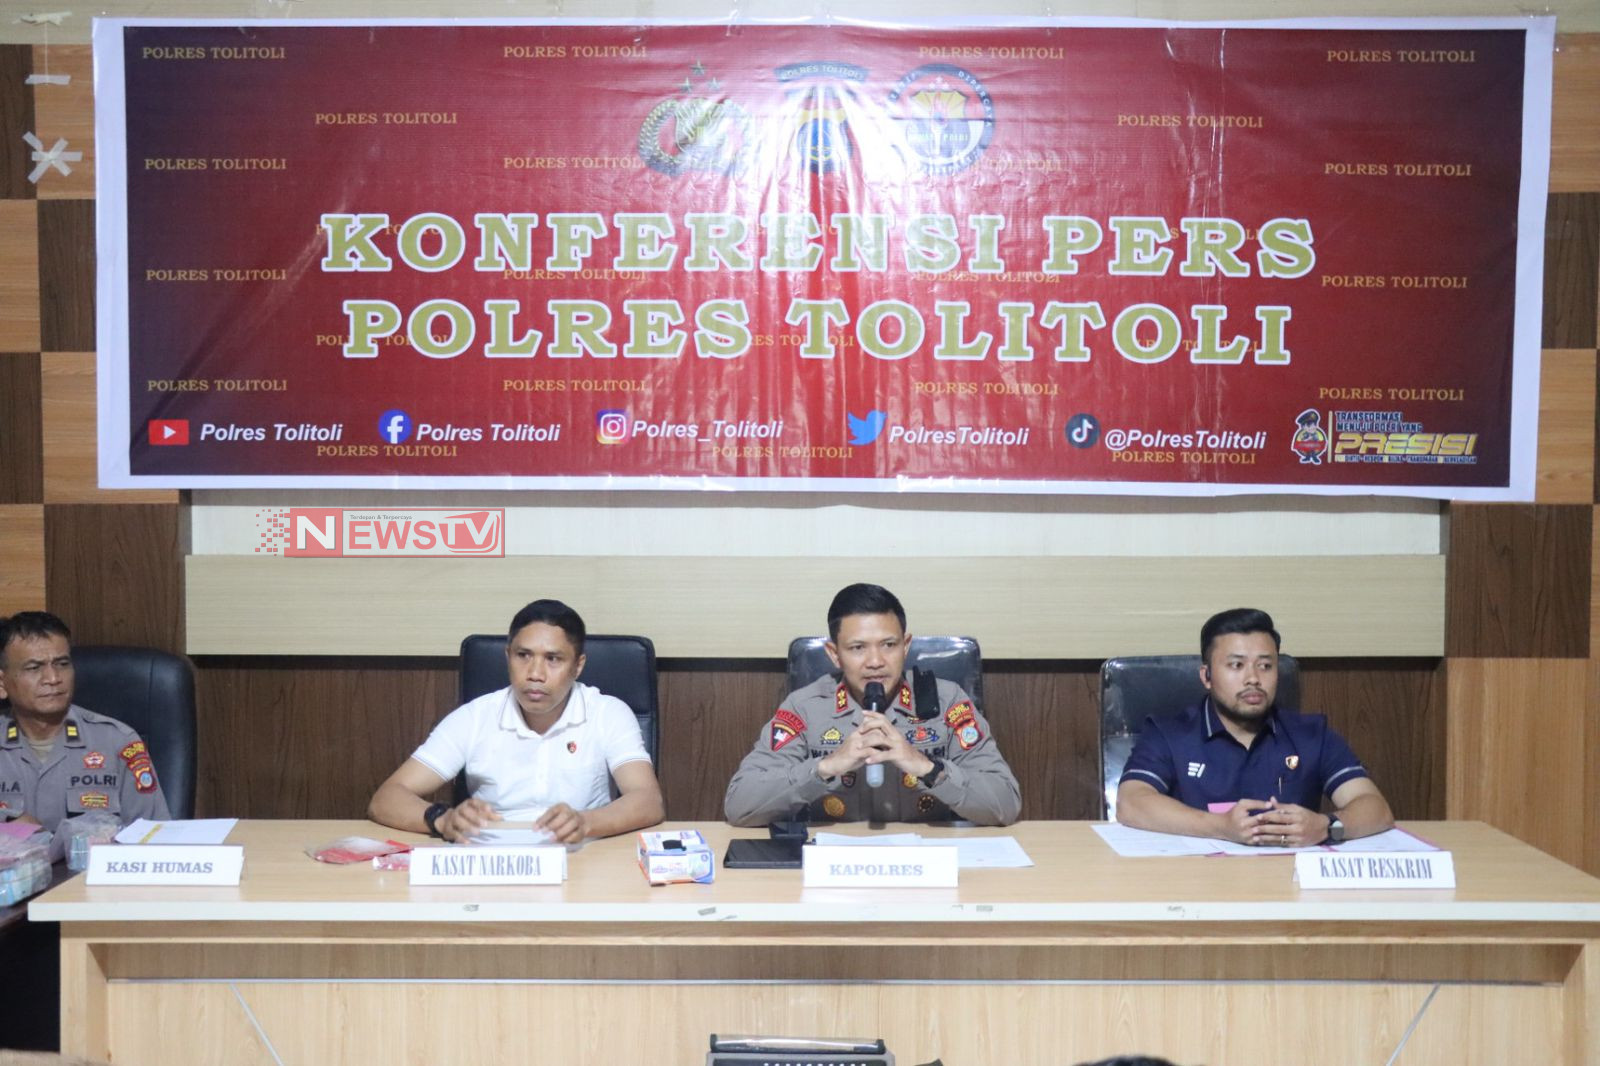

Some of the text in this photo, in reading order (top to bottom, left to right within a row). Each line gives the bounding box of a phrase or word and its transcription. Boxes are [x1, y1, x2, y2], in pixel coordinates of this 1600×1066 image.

[142, 47, 286, 60] POLRES TOLITOLI
[503, 46, 648, 58] POLRES TOLITOLI
[917, 46, 1065, 60] POLRES TOLITOLI
[1326, 50, 1476, 63] POLRES TOLITOLI
[315, 113, 457, 125] POLRES TOLITOLI
[1117, 115, 1264, 128] POLRES TOLITOLI
[144, 158, 287, 170] POLRES TOLITOLI
[503, 157, 567, 169] POLRES
[1324, 163, 1472, 176] POLRES TOLITOLI
[320, 211, 1316, 279] KONFERENSI PERS
[146, 269, 287, 281] POLRES TOLITOLI
[1321, 276, 1468, 288] POLRES TOLITOLI
[342, 298, 1292, 366] POLRES TOLITOLI
[147, 379, 288, 392] POLRES TOLITOLI
[503, 379, 646, 392] POLRES TOLITOLI
[914, 382, 1059, 395] POLRES TOLITOLI
[1319, 388, 1464, 400] POLRES TOLITOLI
[200, 422, 343, 441] Polres Tolitoli
[416, 422, 561, 442] Polres Tolitoli
[631, 419, 783, 443] Polres_Tolitoli
[888, 425, 1030, 447] PolresTolitoli
[1104, 428, 1266, 452] @PolresTolitoli
[1334, 433, 1477, 455] PRESISI
[317, 445, 457, 457] POLRES TOLITOLI
[712, 446, 853, 458] POLRES TOLITOLI
[1112, 450, 1257, 464] POLRES TOLITOLI
[71, 775, 116, 786] POLRI
[106, 862, 213, 873] KASI HUMAS
[431, 854, 541, 877] KASAT NARKOBA
[829, 864, 923, 876] KAPOLRES
[1319, 857, 1433, 880] KASAT RESKRIM
